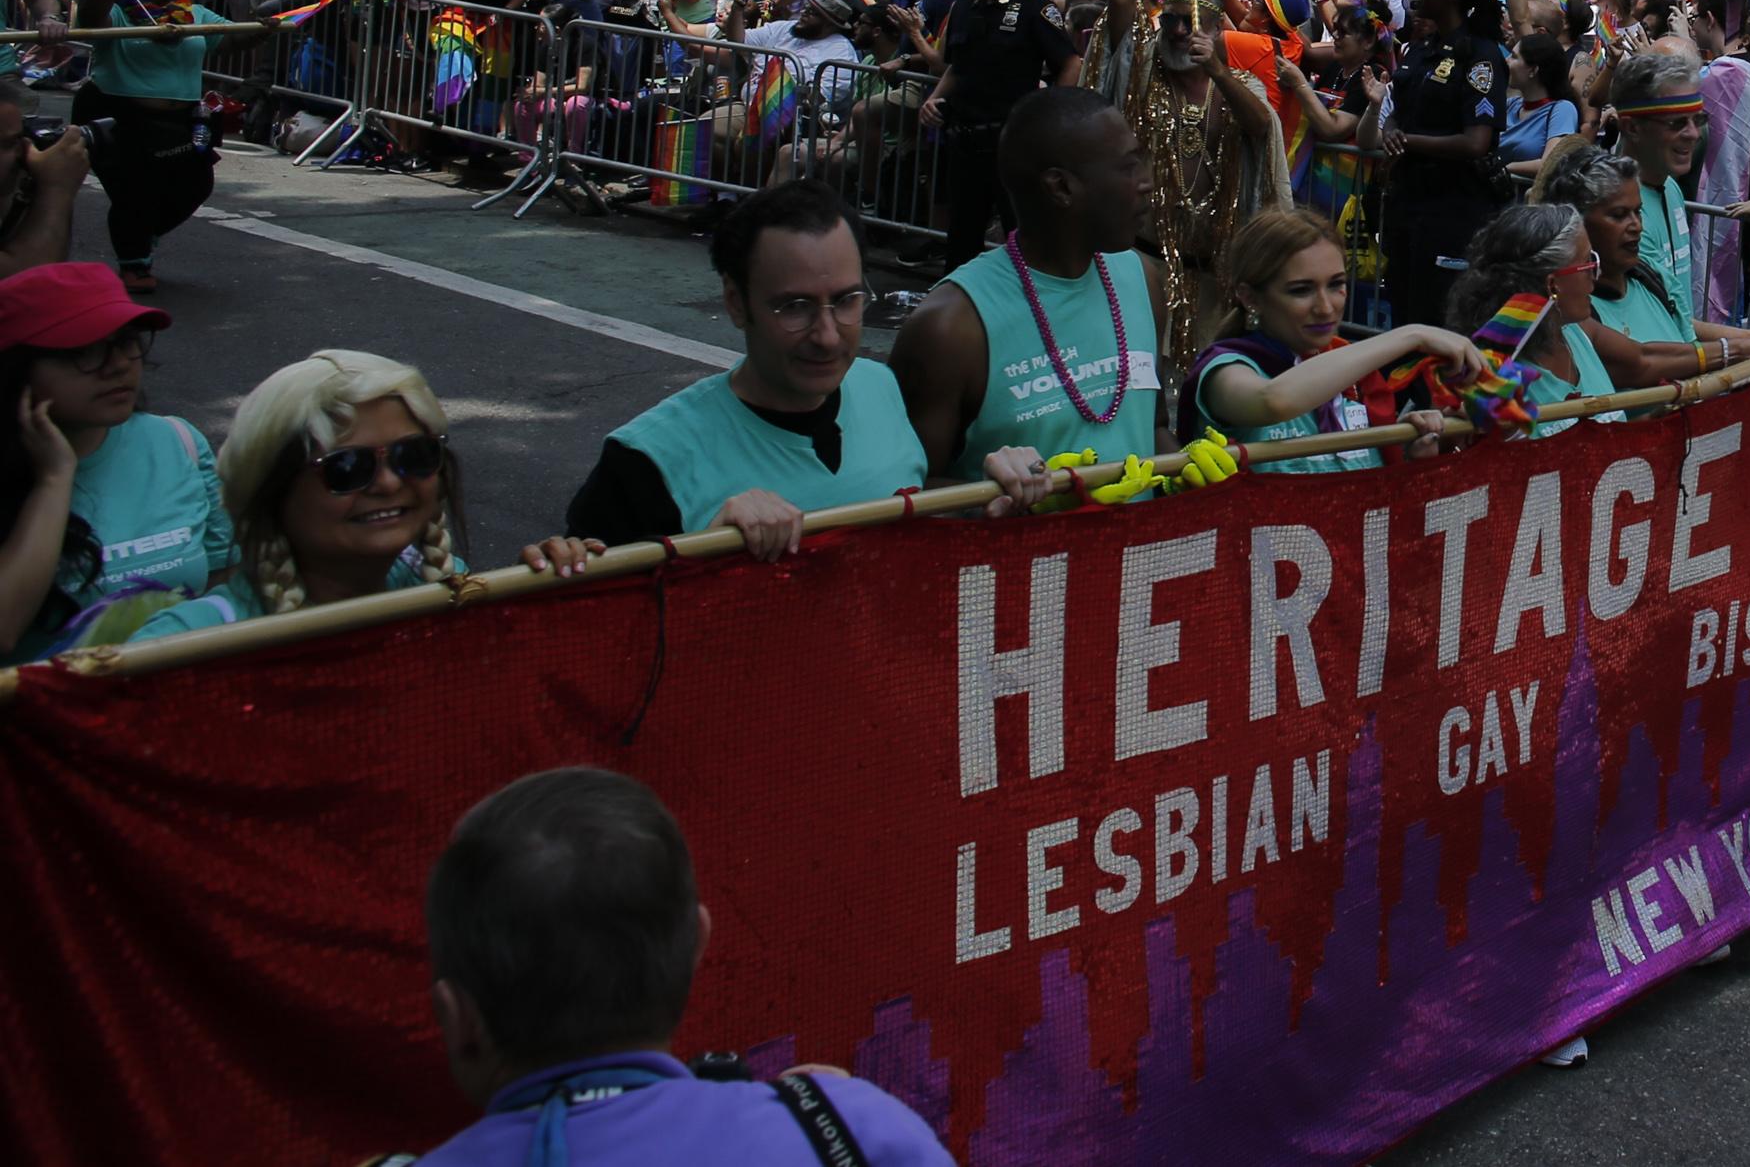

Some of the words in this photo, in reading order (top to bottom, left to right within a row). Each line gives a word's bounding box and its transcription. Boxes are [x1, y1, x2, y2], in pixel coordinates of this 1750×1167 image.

[1004, 359, 1030, 378] the
[1031, 346, 1079, 370] MACH
[1016, 410, 1035, 423] NYC
[1036, 401, 1063, 417] PRIDE
[957, 421, 1744, 798] HERITAGE
[956, 748, 1330, 965] LESBIAN
[1437, 680, 1540, 798] GAY
[1591, 845, 1715, 978] NEW
